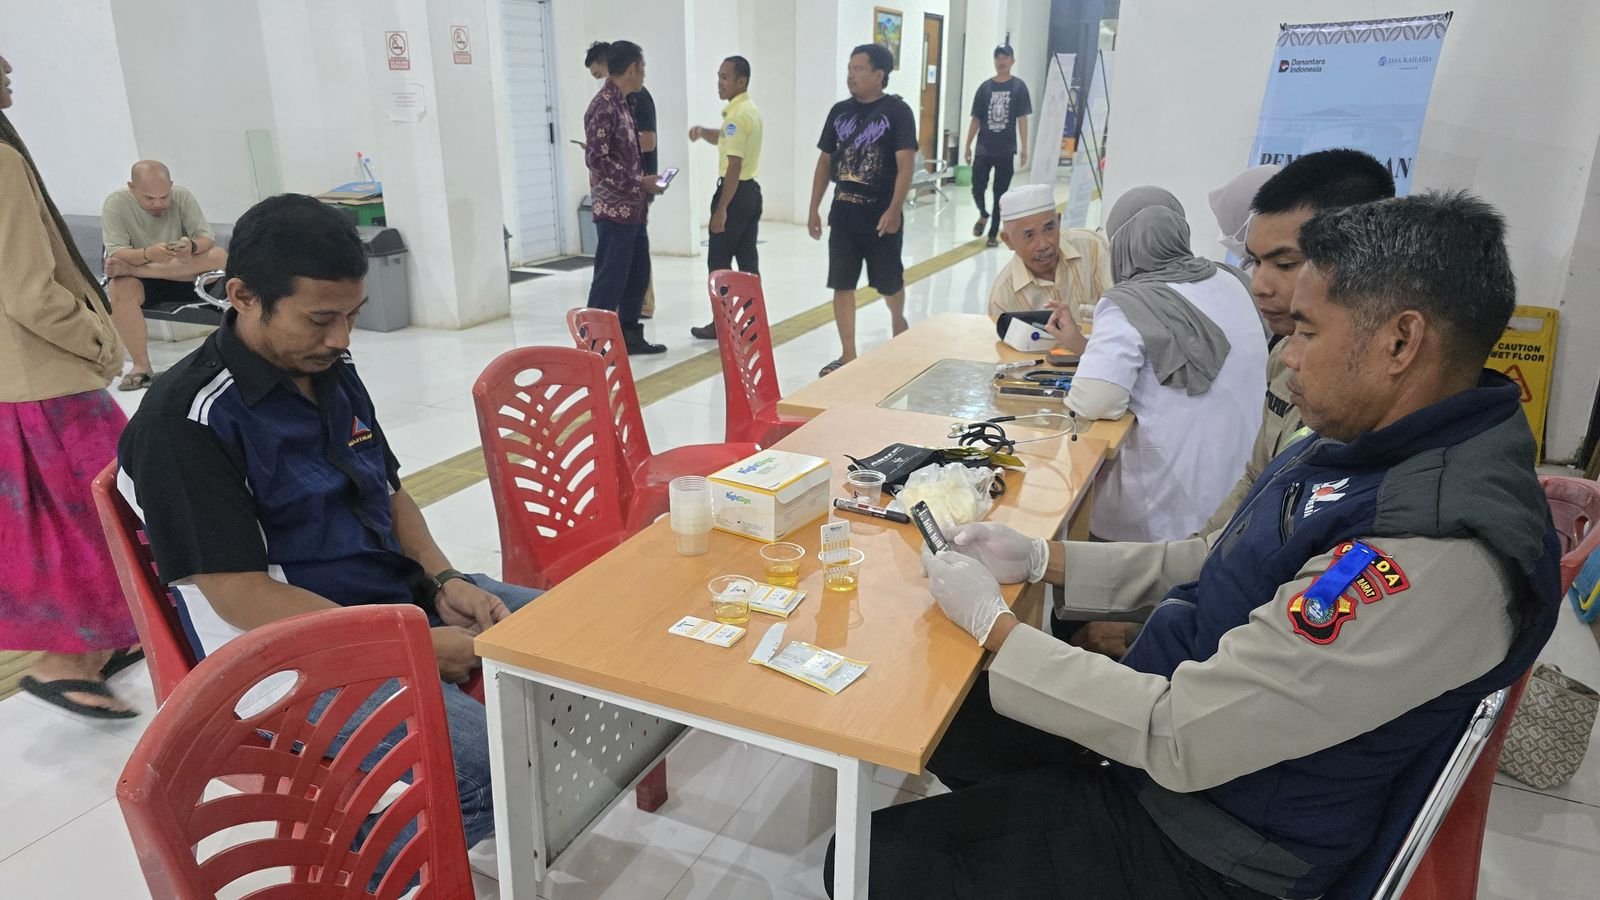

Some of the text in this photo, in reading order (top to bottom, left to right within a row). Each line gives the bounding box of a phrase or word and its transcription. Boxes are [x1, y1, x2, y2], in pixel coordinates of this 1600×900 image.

[1291, 58, 1326, 66] Danantara
[1498, 342, 1541, 353] CAUTION
[1512, 352, 1545, 362] FLOOR
[1356, 578, 1376, 597] BARAT
